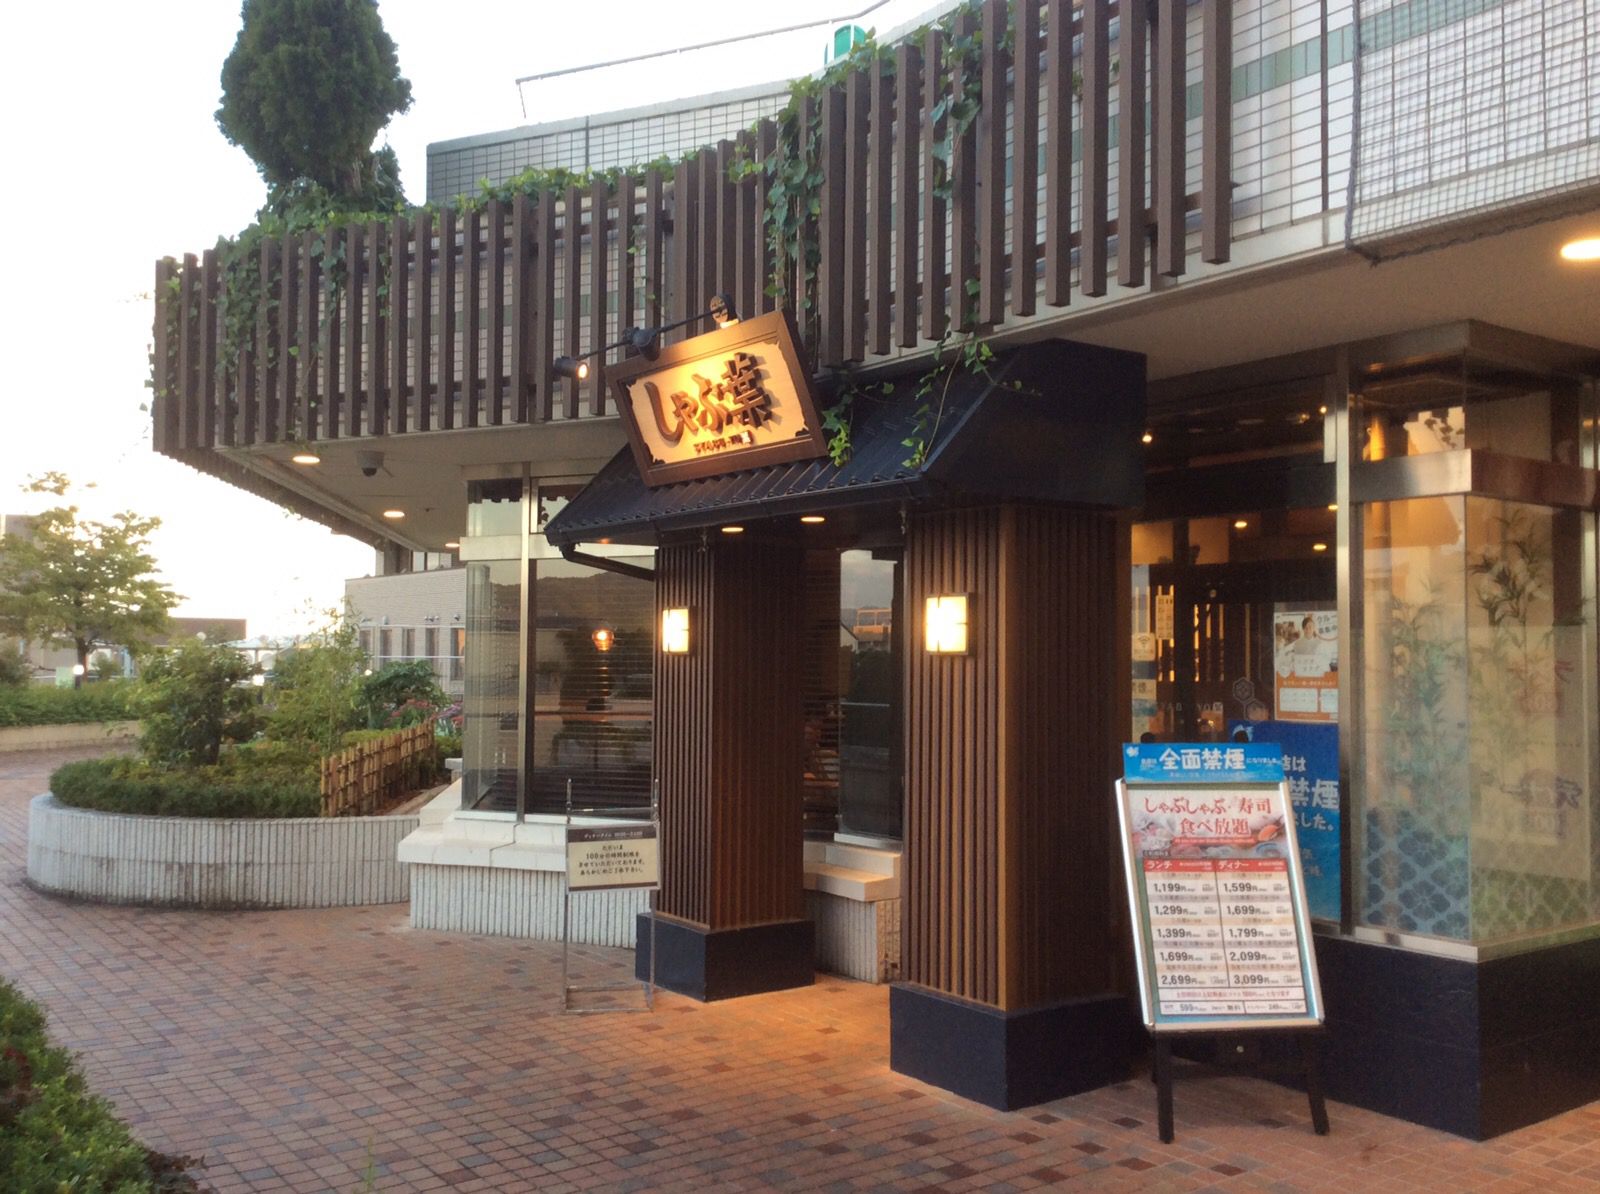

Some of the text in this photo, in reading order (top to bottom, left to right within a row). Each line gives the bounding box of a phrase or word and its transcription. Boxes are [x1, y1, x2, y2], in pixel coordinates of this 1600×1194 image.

[1159, 747, 1246, 770] 全面禁煙
[1181, 817, 1252, 836] 食べ放題
[1147, 859, 1173, 870] ランチ
[1218, 859, 1249, 870] ディナー
